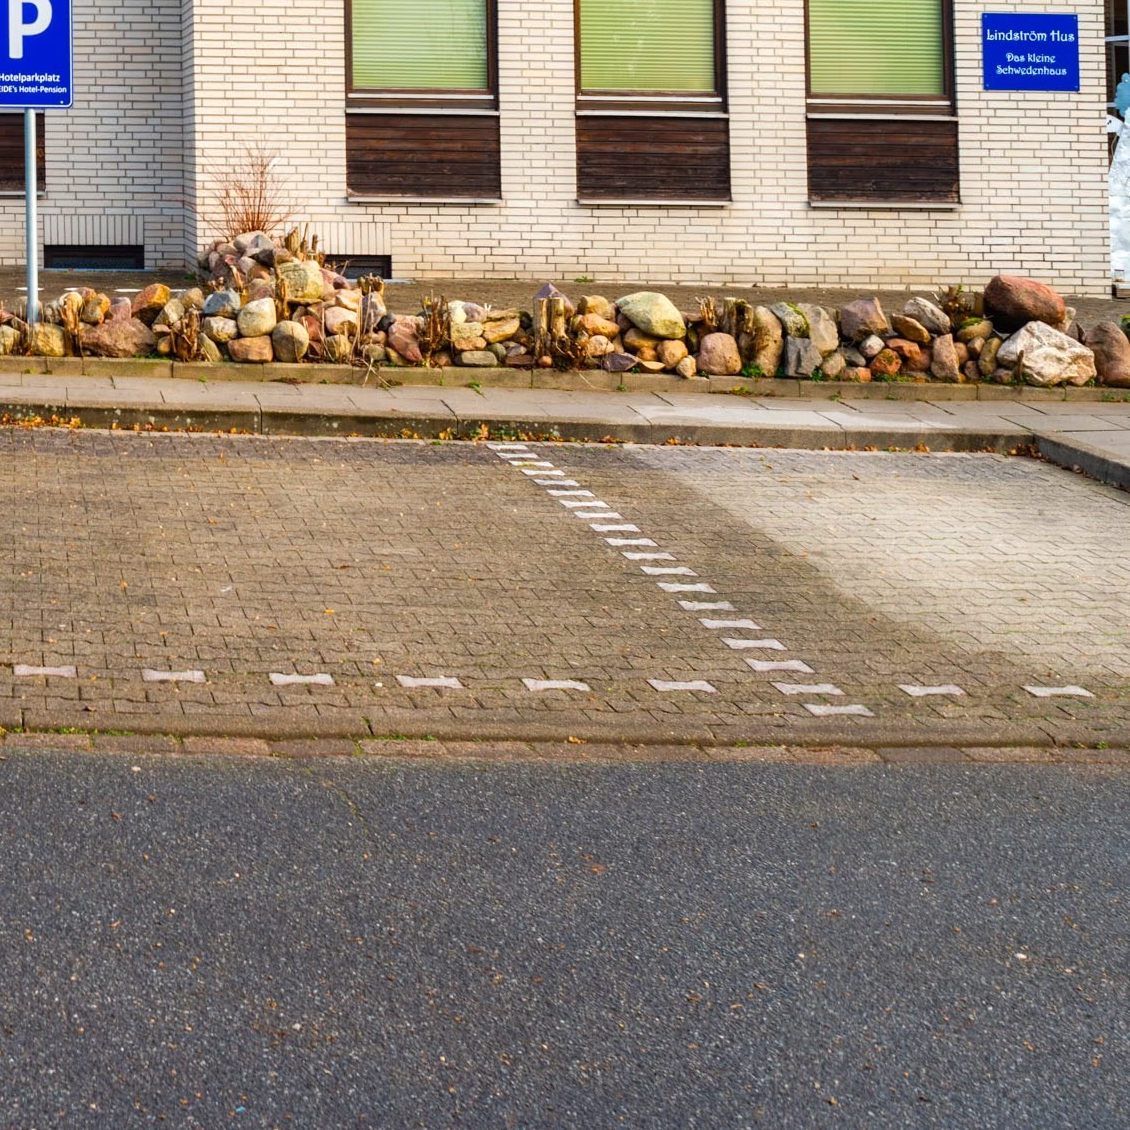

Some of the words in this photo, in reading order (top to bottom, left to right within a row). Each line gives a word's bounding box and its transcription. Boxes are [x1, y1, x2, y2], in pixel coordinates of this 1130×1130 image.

[986, 29, 1047, 41] Lindström
[1049, 30, 1075, 42] Hus
[1006, 53, 1025, 62] Das
[1027, 53, 1056, 63] kleine
[996, 65, 1067, 76] Schwedenhaus
